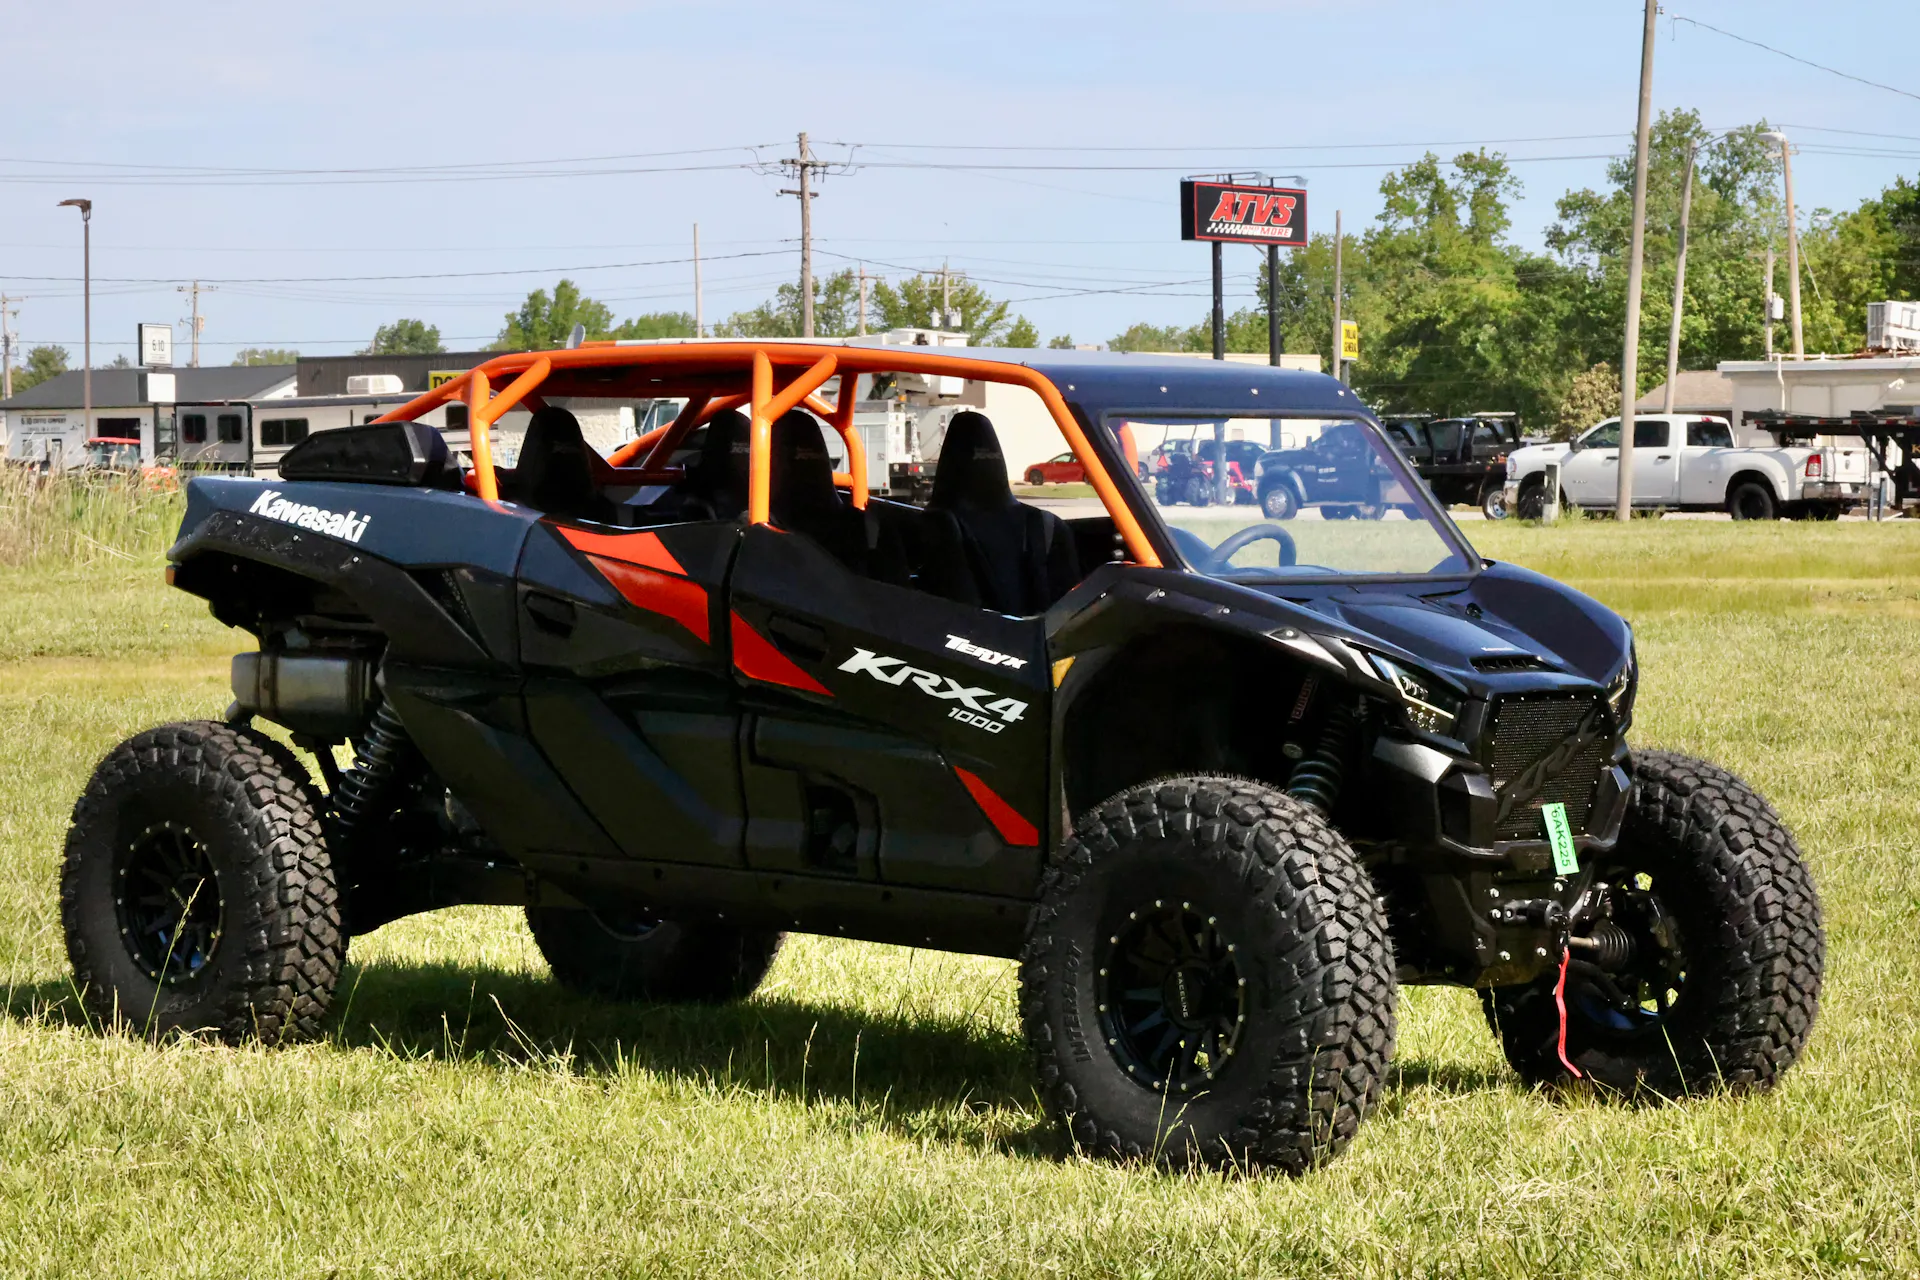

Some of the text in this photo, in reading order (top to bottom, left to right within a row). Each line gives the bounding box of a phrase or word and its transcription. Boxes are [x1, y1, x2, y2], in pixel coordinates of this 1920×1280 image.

[1209, 191, 1297, 226] ATVS
[1260, 227, 1290, 236] MORE
[249, 489, 371, 543] Kawasaki
[948, 707, 1005, 734] 1000
[1177, 971, 1189, 1018] RACELINE
